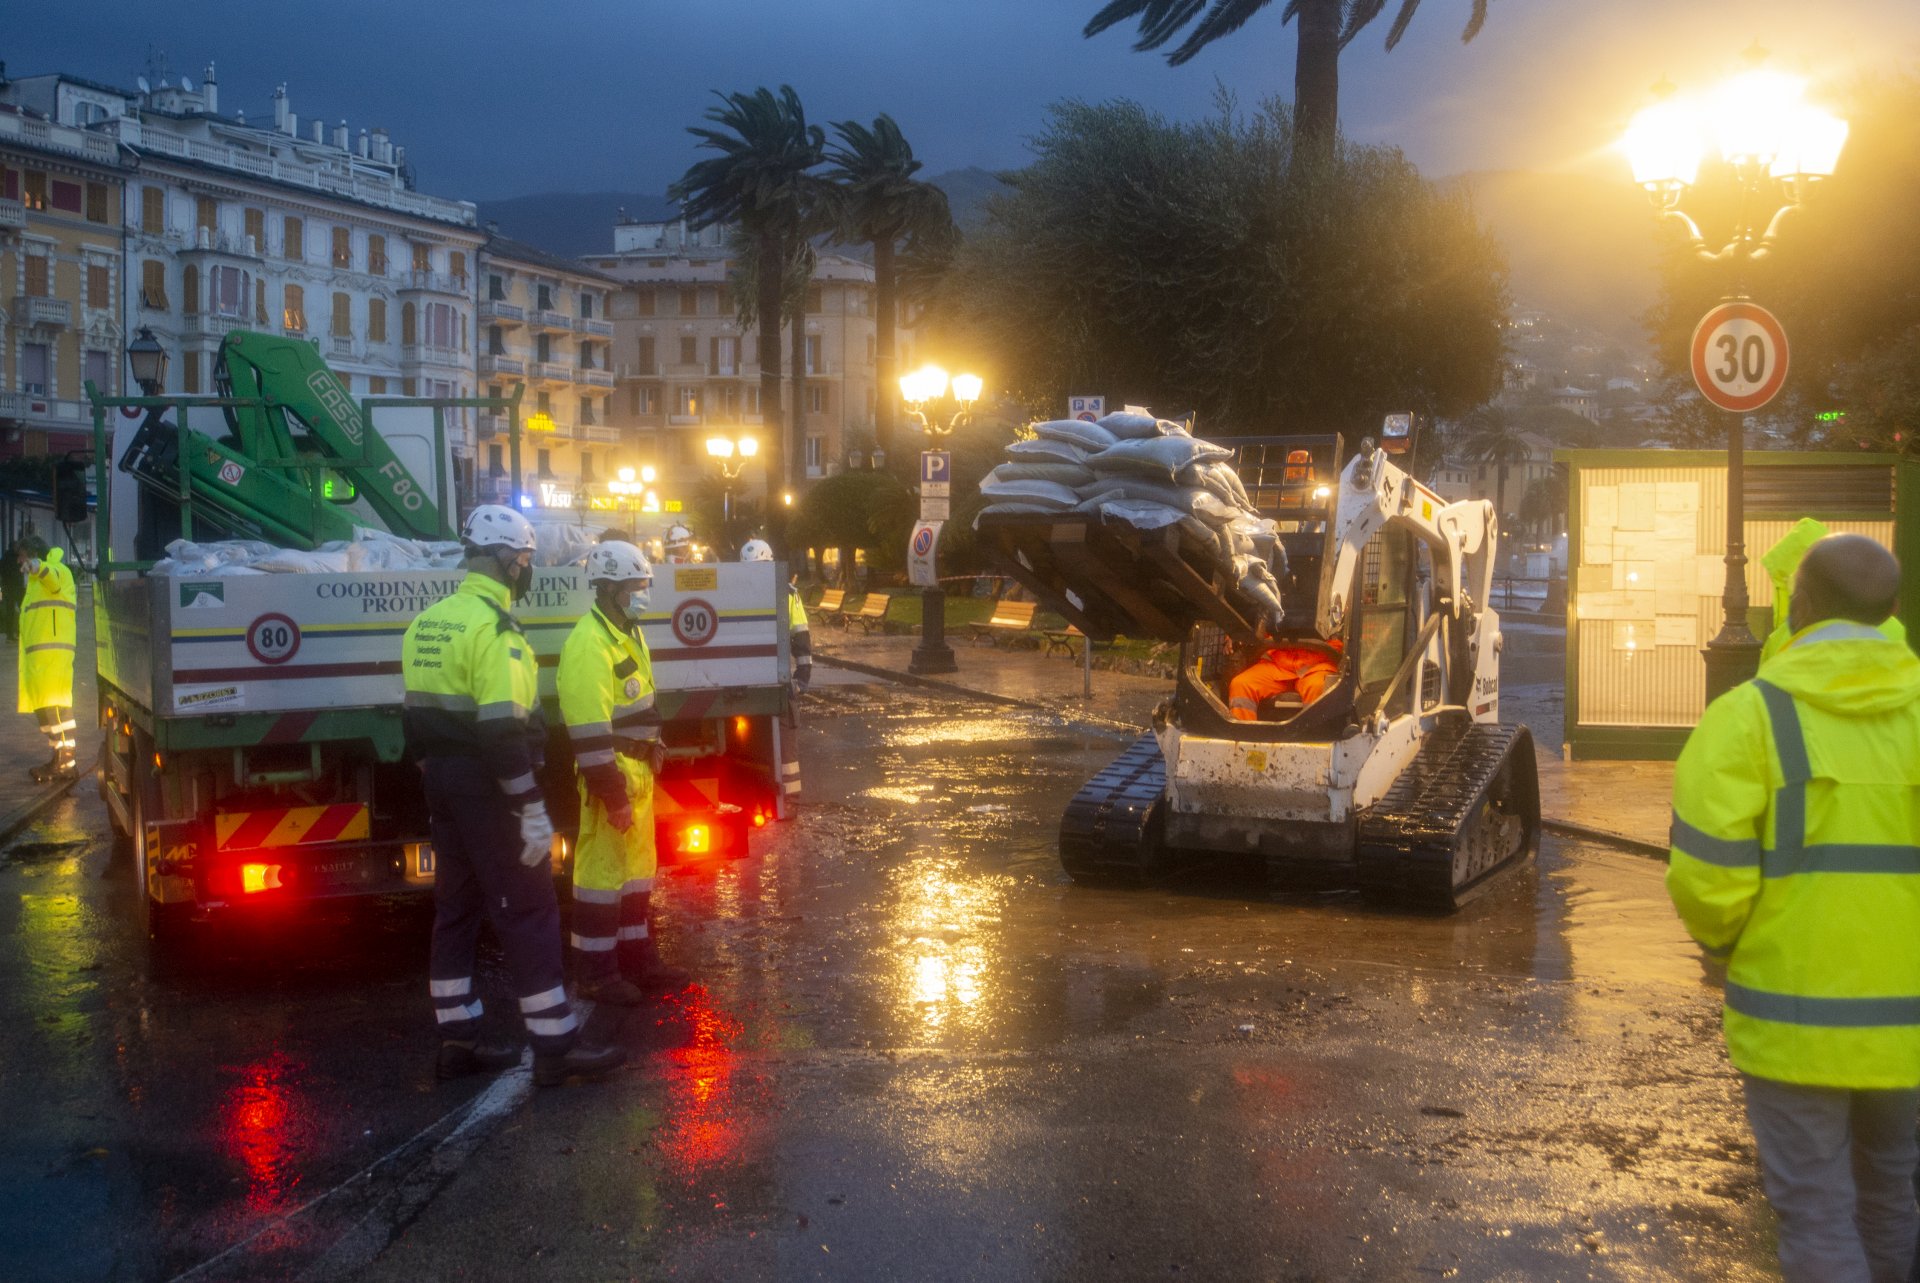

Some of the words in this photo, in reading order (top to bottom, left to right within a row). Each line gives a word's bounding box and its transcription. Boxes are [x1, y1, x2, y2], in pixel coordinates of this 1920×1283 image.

[1715, 333, 1766, 384] 30
[1075, 400, 1083, 409] P
[926, 455, 945, 480] P
[378, 459, 423, 511] F80
[540, 483, 572, 508] VESU
[315, 577, 461, 600] COORDINAME
[529, 575, 578, 592] LPINI
[361, 592, 447, 613] PROTEZ
[515, 591, 569, 608] IVILE
[683, 612, 707, 633] 90
[261, 627, 288, 649] 80
[1483, 675, 1498, 697] Bobcat
